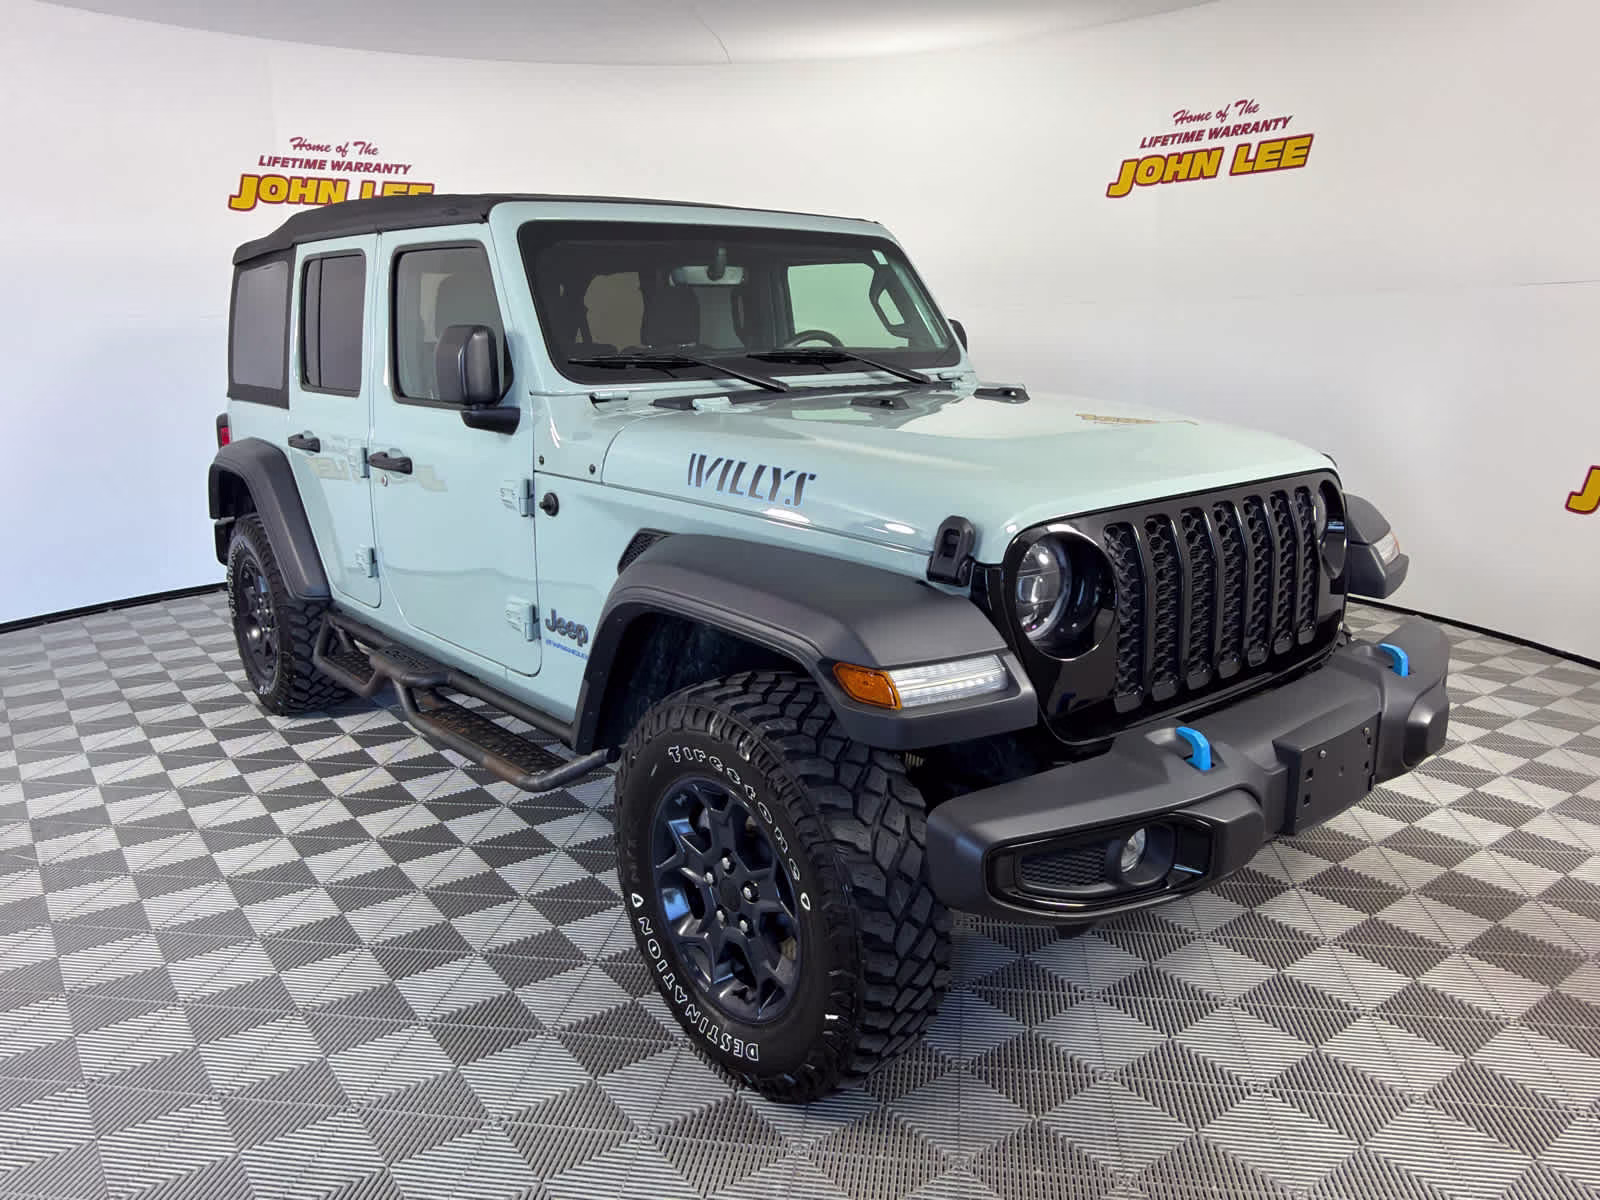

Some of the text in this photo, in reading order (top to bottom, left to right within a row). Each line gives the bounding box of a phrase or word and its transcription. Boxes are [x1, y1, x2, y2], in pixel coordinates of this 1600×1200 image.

[1173, 99, 1260, 126] Home of The
[289, 136, 379, 158] Home of The
[1139, 116, 1293, 149] LIFETIME WARRANTY
[258, 155, 412, 175] LIFETIME WARRANTY
[1106, 133, 1314, 198] JOHN LEE
[228, 173, 350, 211] JOHN
[687, 452, 817, 507] WILLYS
[545, 608, 589, 648] Jeep
[638, 916, 759, 1062] DESTINATION
